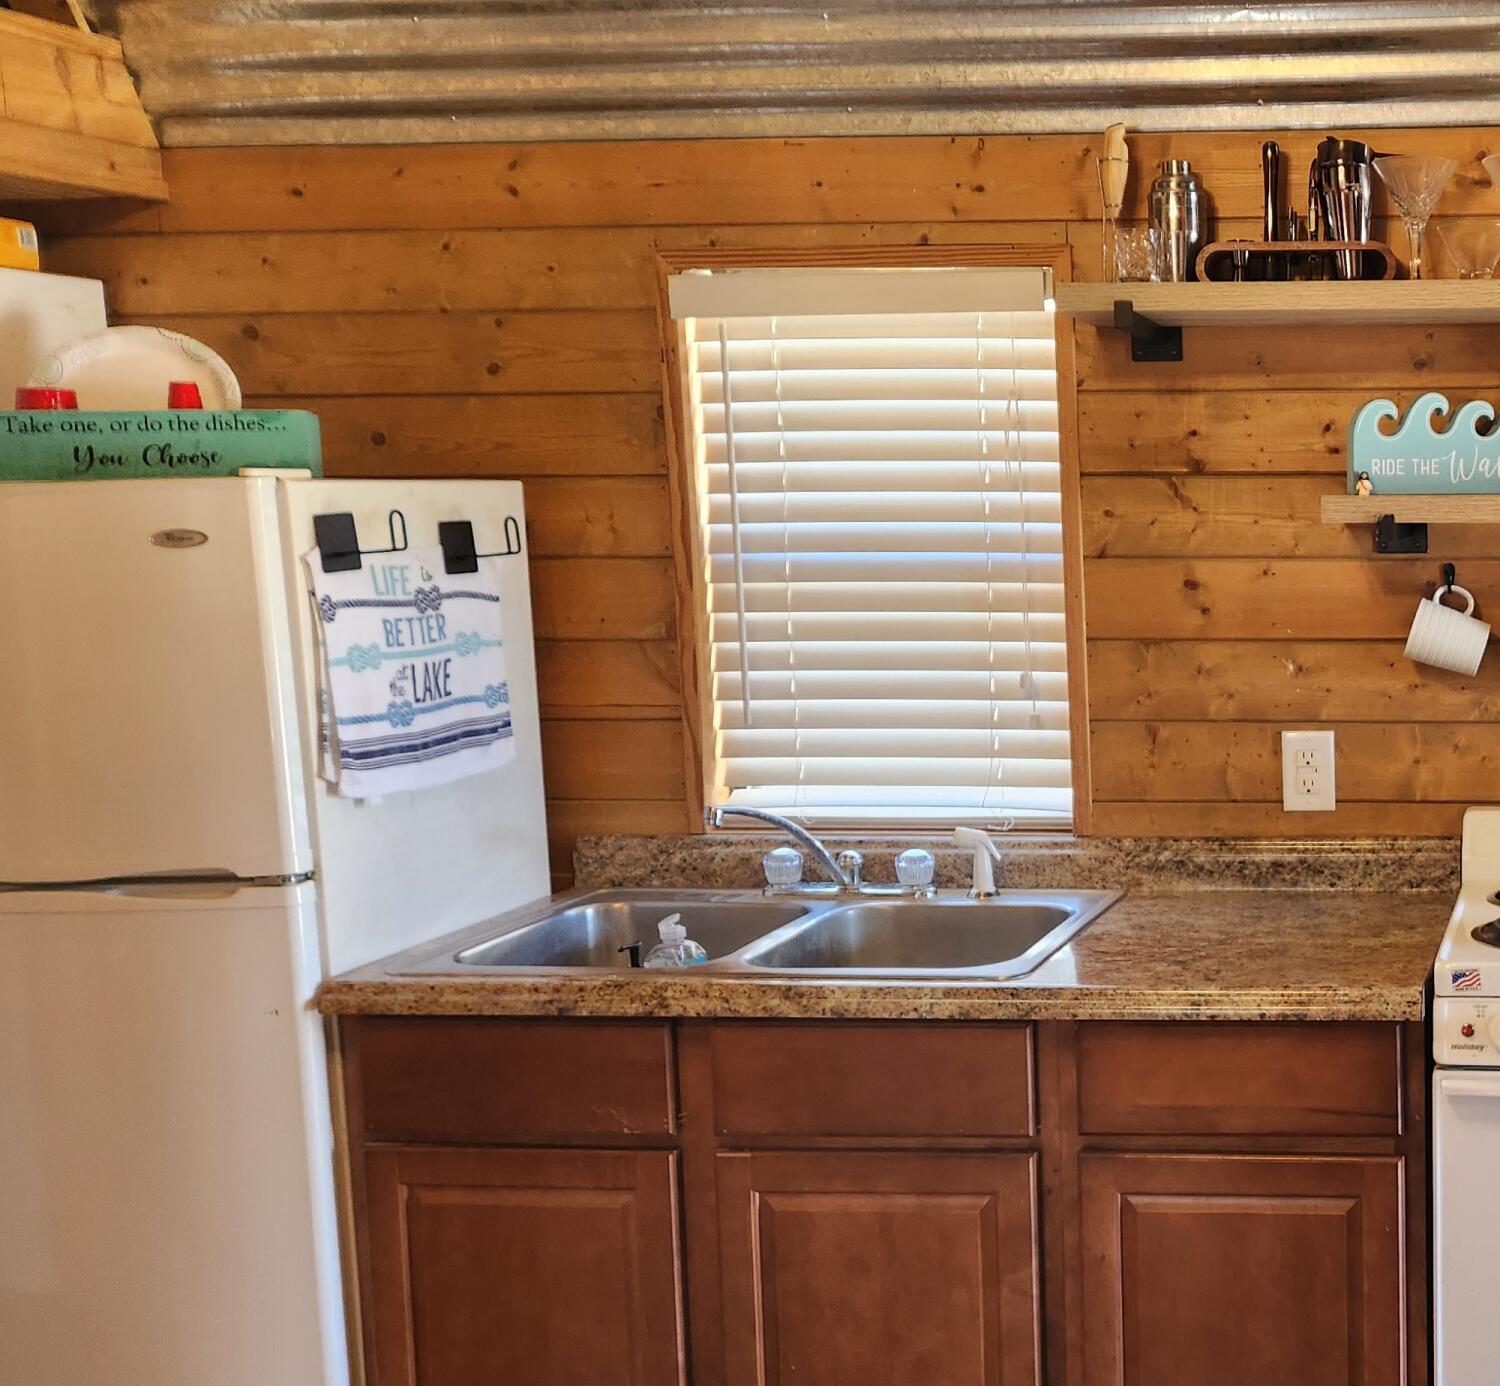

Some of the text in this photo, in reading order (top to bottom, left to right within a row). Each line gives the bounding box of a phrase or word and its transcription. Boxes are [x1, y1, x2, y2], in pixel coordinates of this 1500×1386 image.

[5, 415, 53, 434] Take
[60, 419, 103, 434] one,
[109, 419, 132, 433] or
[137, 414, 163, 433] do
[168, 414, 199, 432] the
[72, 443, 222, 474] You Choose
[1372, 458, 1405, 475] RIDE
[1412, 458, 1440, 475] THE
[370, 564, 434, 596] LIFE is
[382, 612, 447, 648] BETTER
[389, 658, 452, 703] at the LAKE
